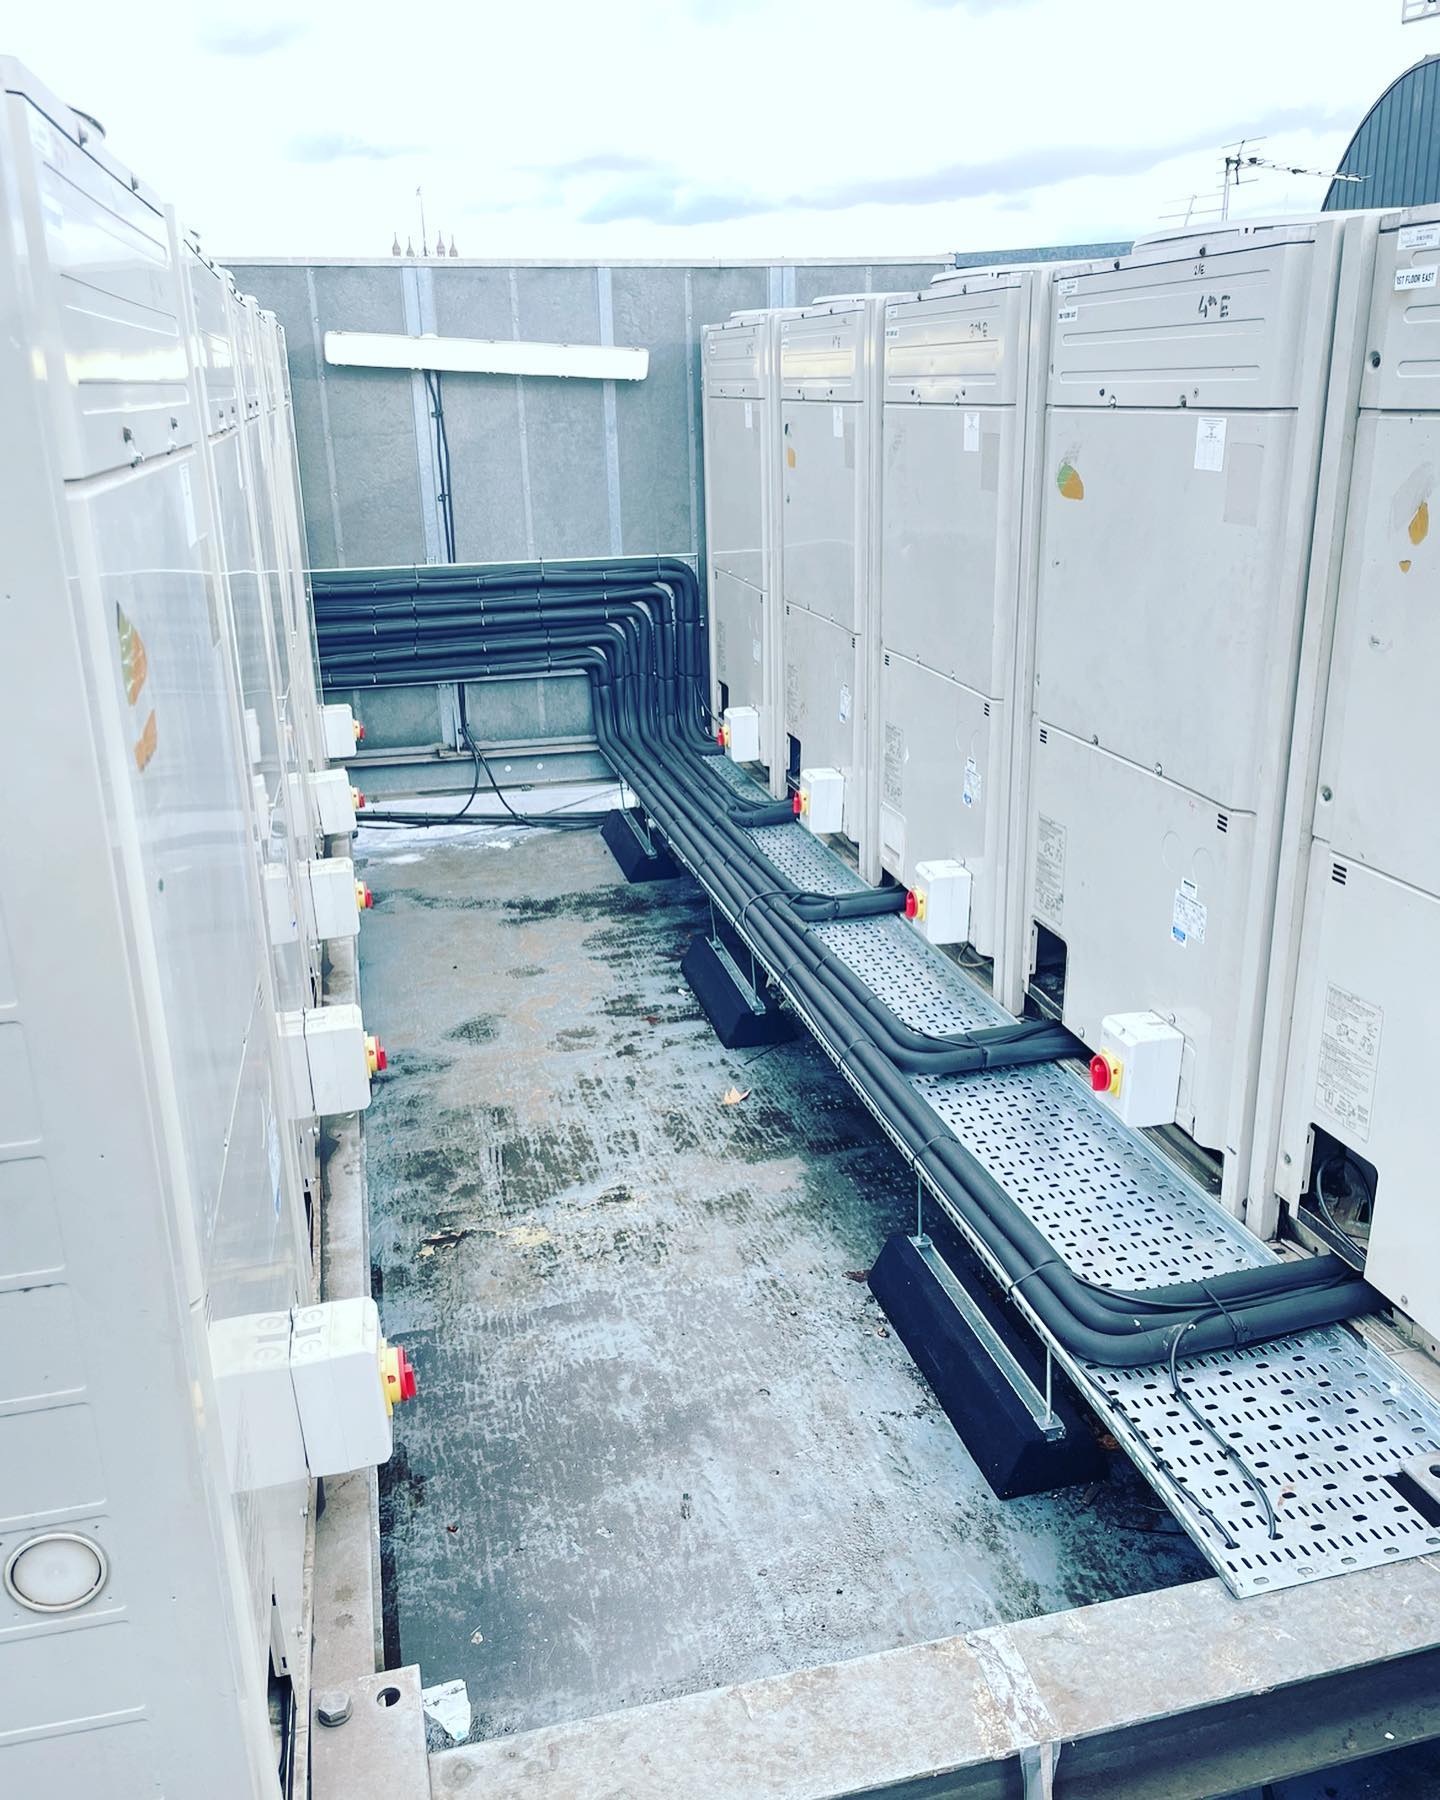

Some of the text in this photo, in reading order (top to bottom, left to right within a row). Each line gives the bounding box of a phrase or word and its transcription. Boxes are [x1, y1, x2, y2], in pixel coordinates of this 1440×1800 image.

[1396, 272, 1435, 285] 1ST FLOOR EAST
